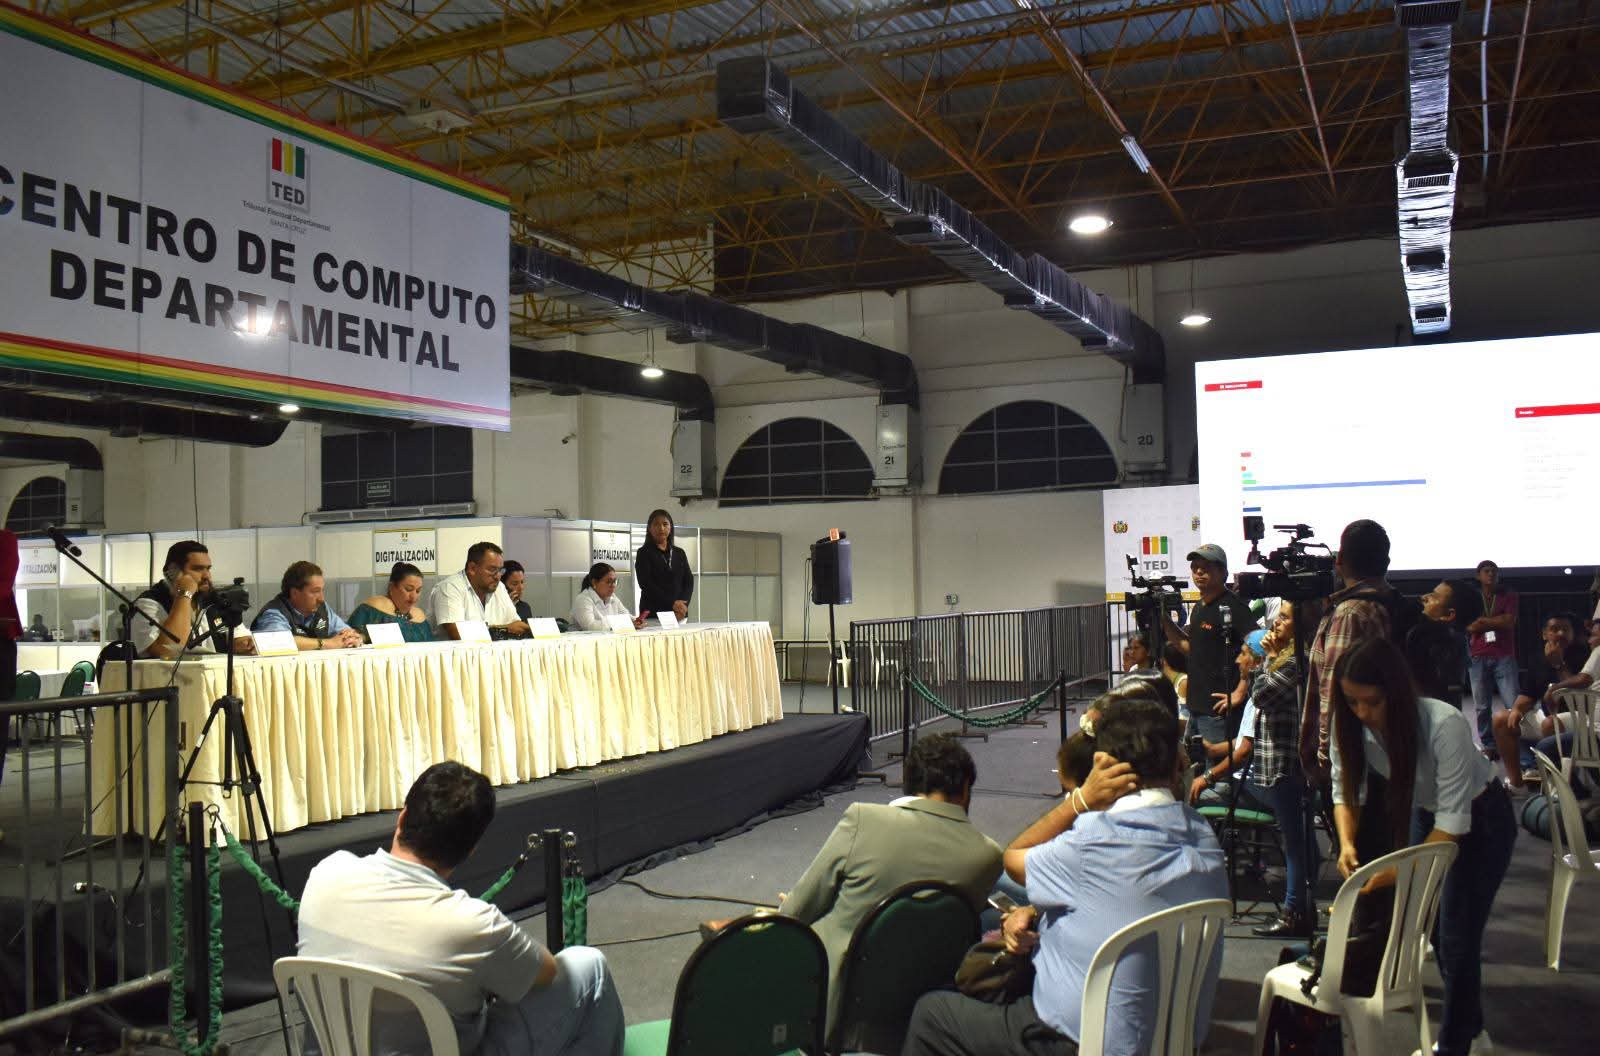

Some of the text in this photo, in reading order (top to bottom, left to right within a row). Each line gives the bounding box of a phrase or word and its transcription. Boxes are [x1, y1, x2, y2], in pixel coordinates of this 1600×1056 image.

[271, 181, 305, 205] TED
[237, 229, 296, 284] DE
[312, 252, 497, 330] COMPUTO
[50, 248, 460, 372] DEPARTAMENTAL
[1137, 434, 1153, 446] 20
[884, 455, 894, 465] 21
[680, 464, 693, 474] 22
[375, 547, 435, 562] DIGITALIZACIÓN
[1143, 560, 1169, 570] TED
